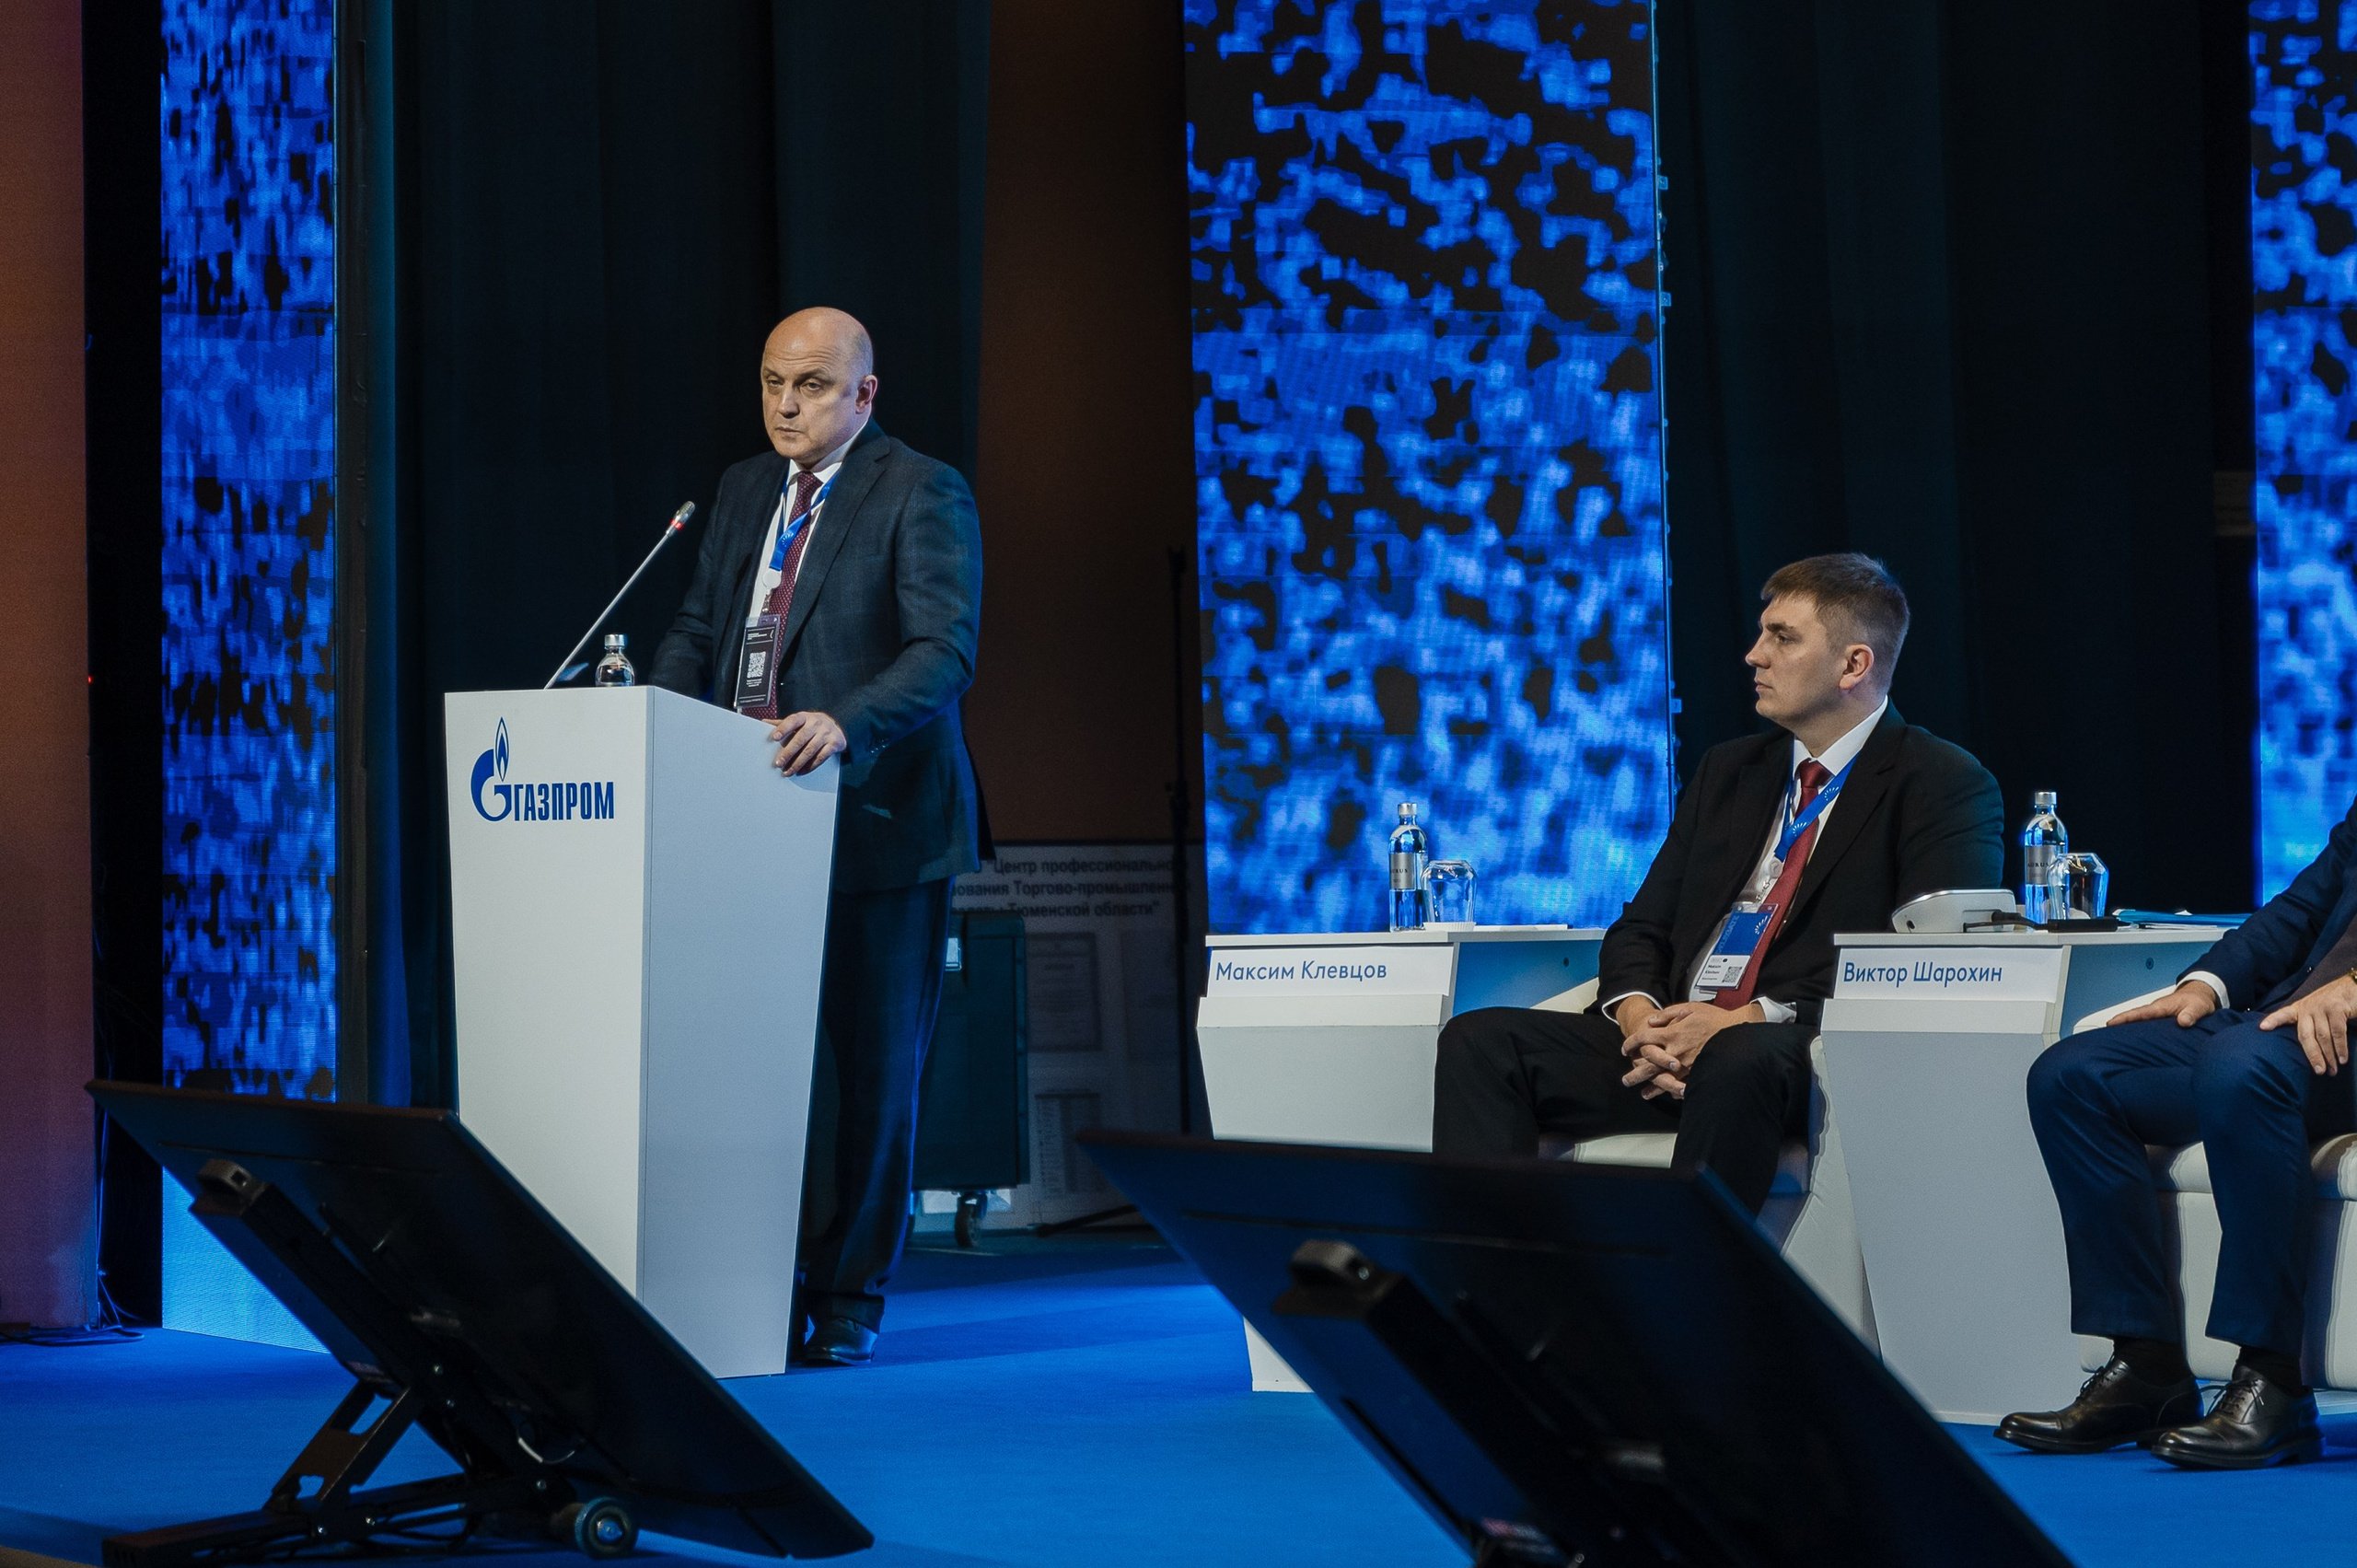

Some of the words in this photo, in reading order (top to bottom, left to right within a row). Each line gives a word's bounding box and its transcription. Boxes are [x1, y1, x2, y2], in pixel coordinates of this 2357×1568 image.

[514, 782, 614, 821] ГАЗПРОМ
[1041, 858, 1188, 876] профессионально
[1013, 880, 1192, 900] Торгово-промышленн
[1095, 900, 1160, 917] области"
[1215, 961, 1295, 981] Максим
[1301, 960, 1387, 981] Клевцов
[1843, 962, 1908, 988] Виктор
[1913, 961, 2003, 988] Шарохин
